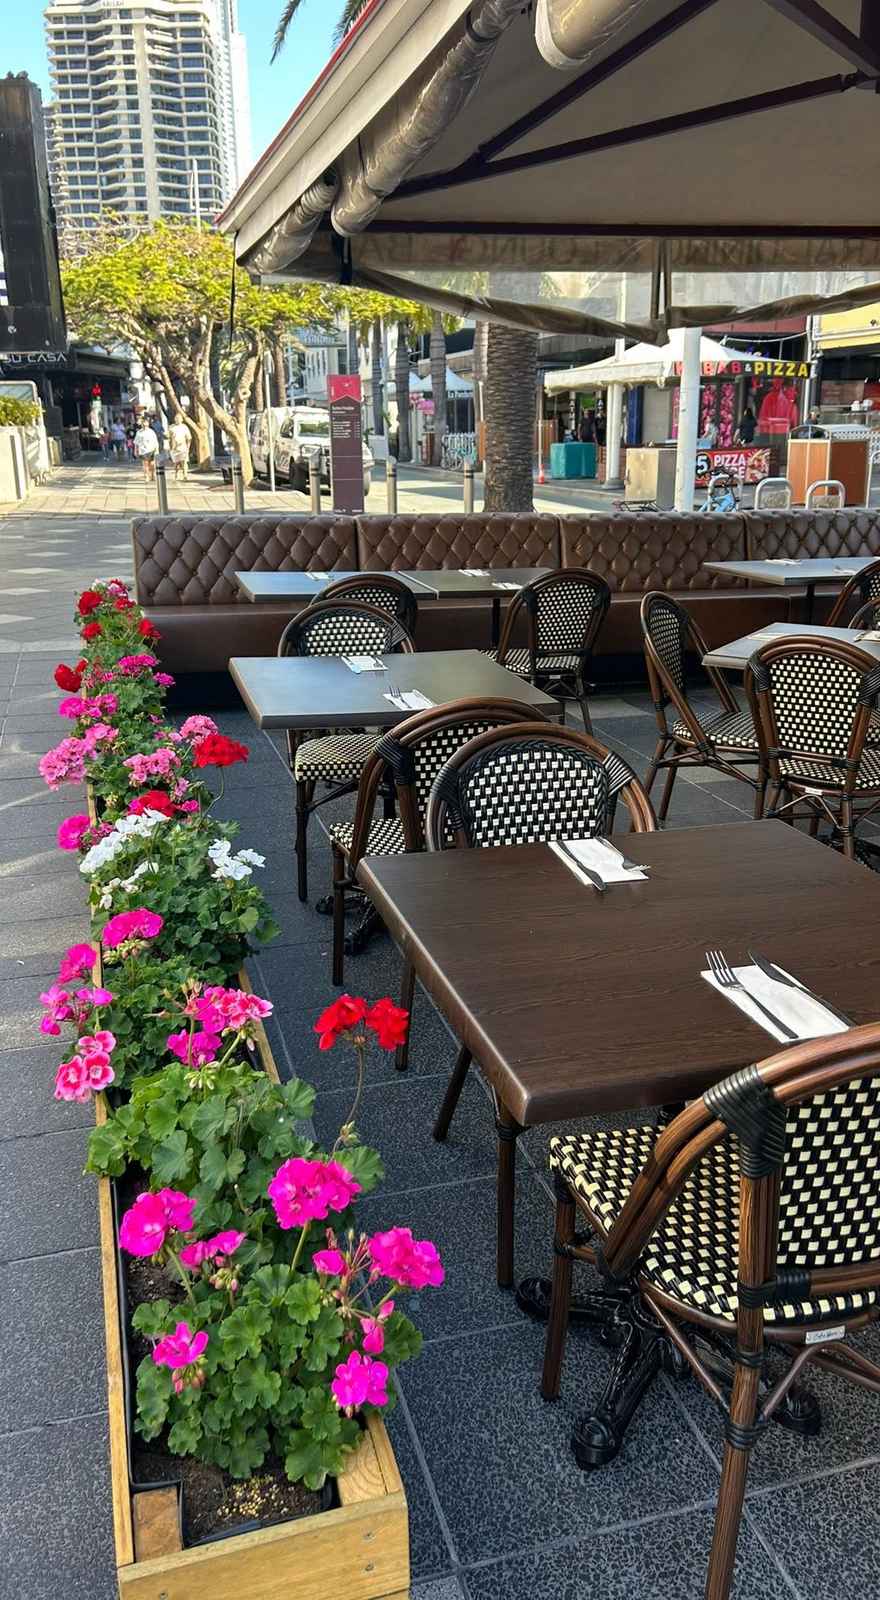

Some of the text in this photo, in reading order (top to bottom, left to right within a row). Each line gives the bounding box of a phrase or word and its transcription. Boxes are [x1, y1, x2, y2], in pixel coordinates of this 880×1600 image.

[672, 360, 742, 376] KBAB
[754, 361, 809, 378] PIZZA
[713, 453, 746, 467] PIZZA
